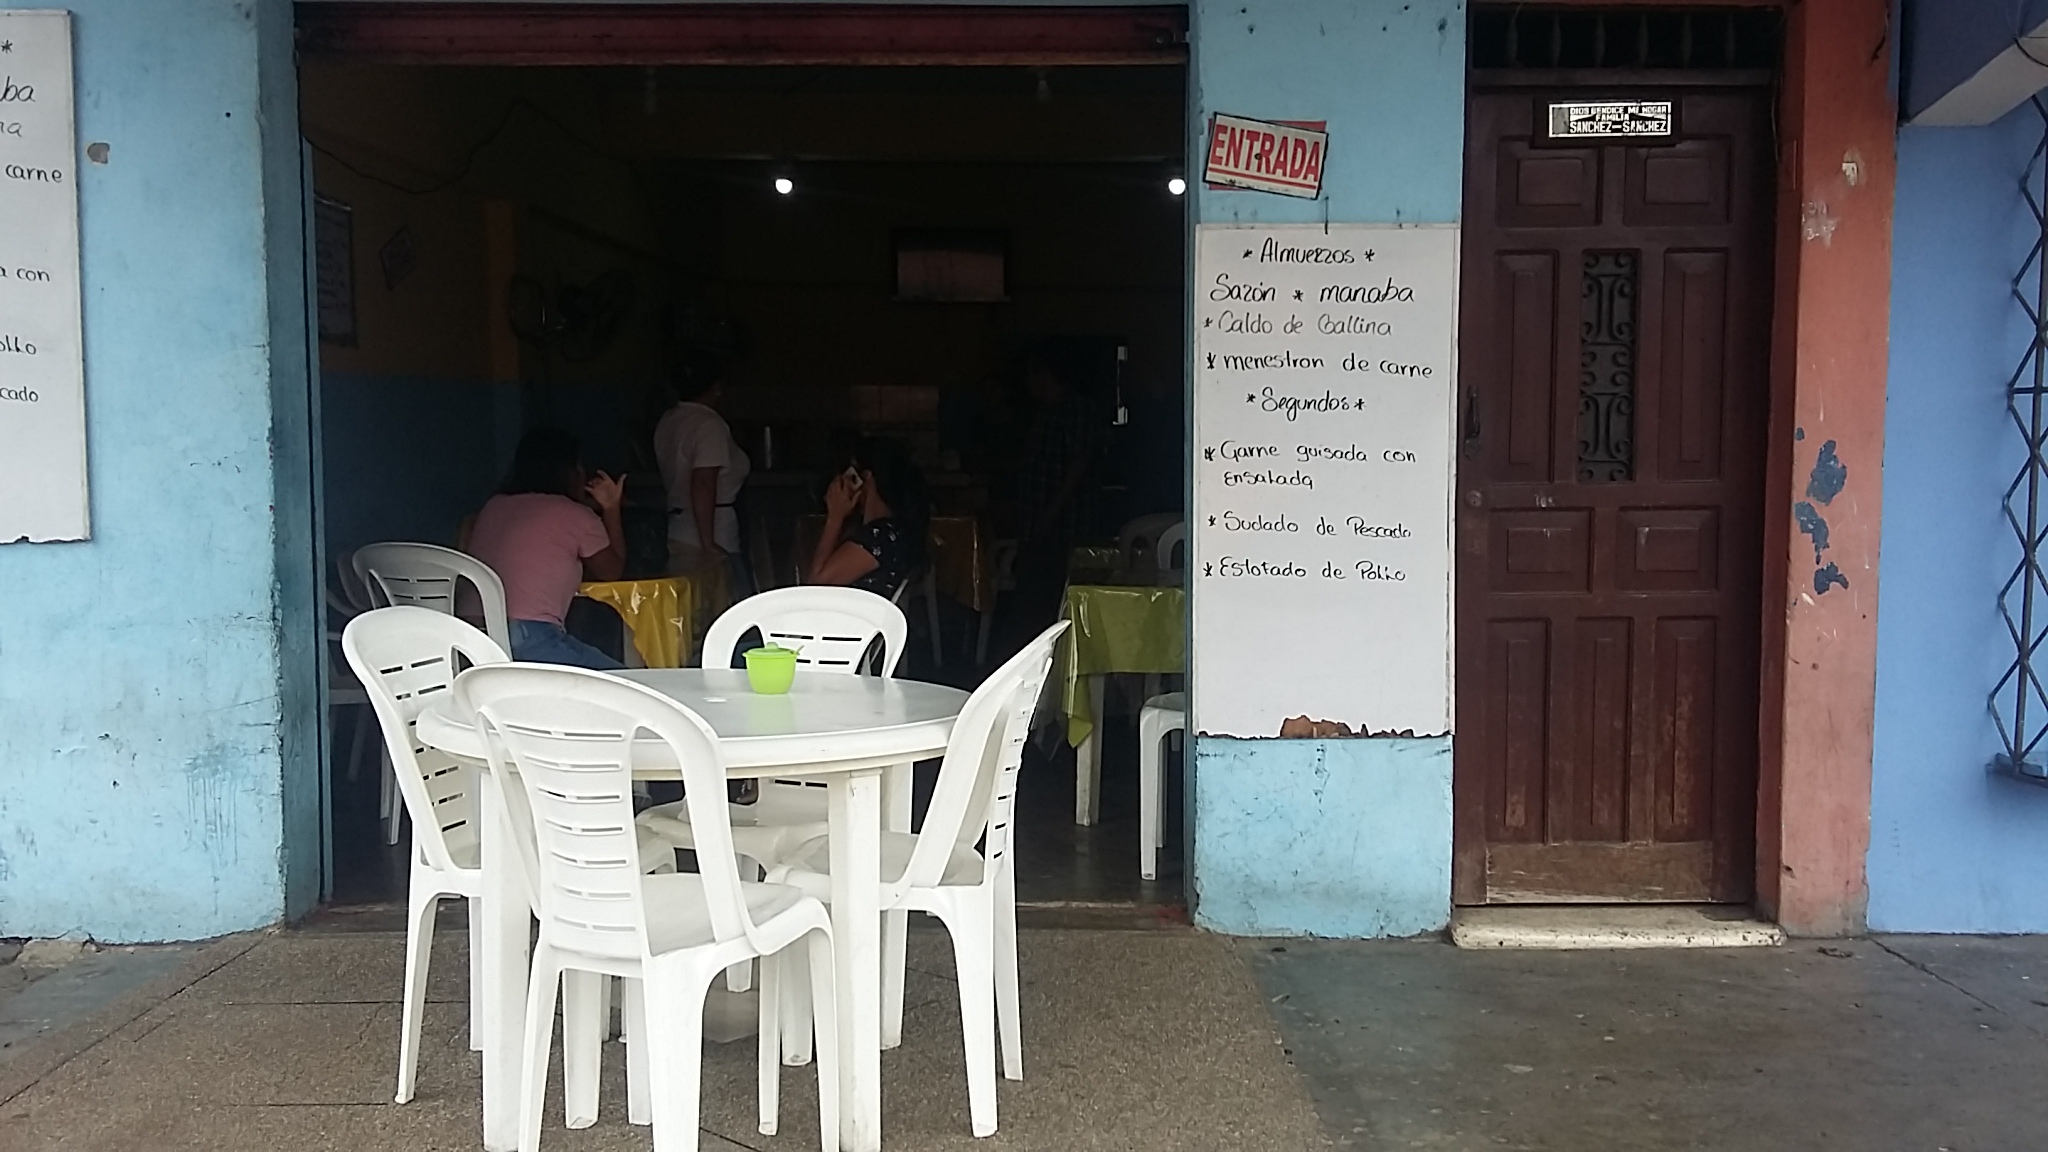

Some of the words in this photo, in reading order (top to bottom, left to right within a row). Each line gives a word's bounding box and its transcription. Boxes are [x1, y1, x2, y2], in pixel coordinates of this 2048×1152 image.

[1210, 124, 1320, 182] ENTRADA
[6, 164, 62, 183] carne
[16, 267, 50, 282] con
[1320, 277, 1415, 303] manaba
[1218, 310, 1273, 335] Caldo
[1283, 314, 1303, 334] de
[1343, 353, 1370, 372] de
[1379, 360, 1432, 378] carne
[1262, 387, 1349, 420] Segundos
[1297, 444, 1367, 463] guisada
[1383, 450, 1417, 464] con
[1224, 511, 1299, 532] Sudado
[1316, 517, 1337, 536] de
[1322, 561, 1346, 579] de
